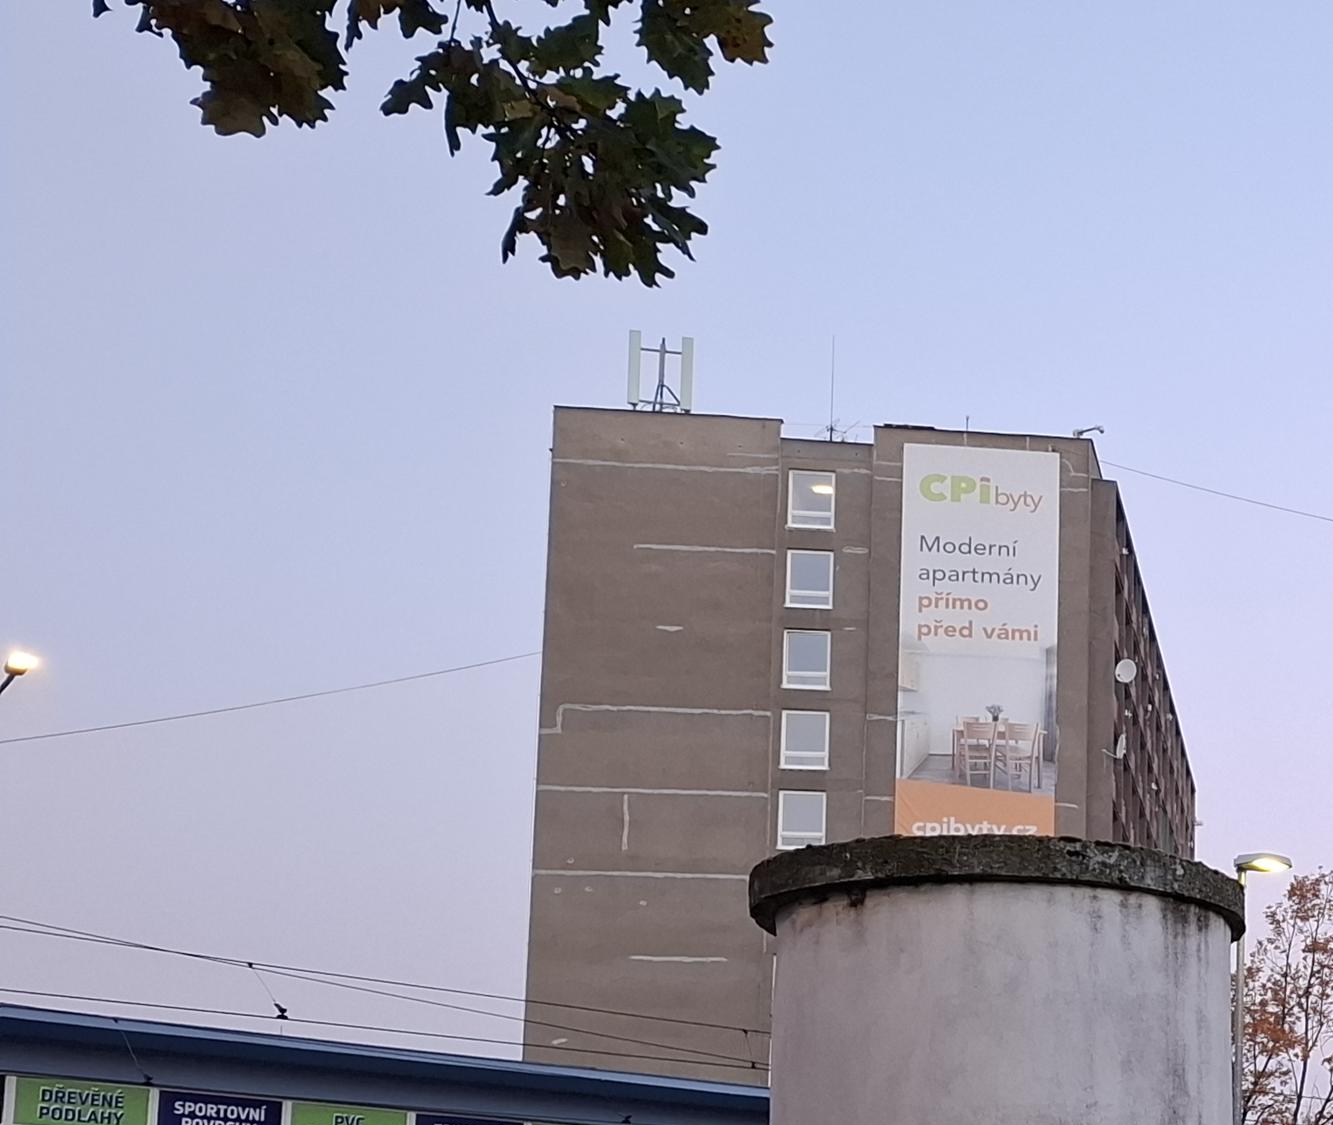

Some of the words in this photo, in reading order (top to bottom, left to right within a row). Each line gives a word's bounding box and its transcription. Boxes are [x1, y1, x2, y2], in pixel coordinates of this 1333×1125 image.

[918, 535, 1019, 558] Moderní
[918, 564, 1042, 591] apartmány
[917, 591, 989, 615] přímo
[917, 620, 974, 642] před
[982, 623, 1039, 643] vámi
[39, 1084, 125, 1110] DŘEVĚNÉ
[173, 1100, 266, 1122] SPORTOVNÍ
